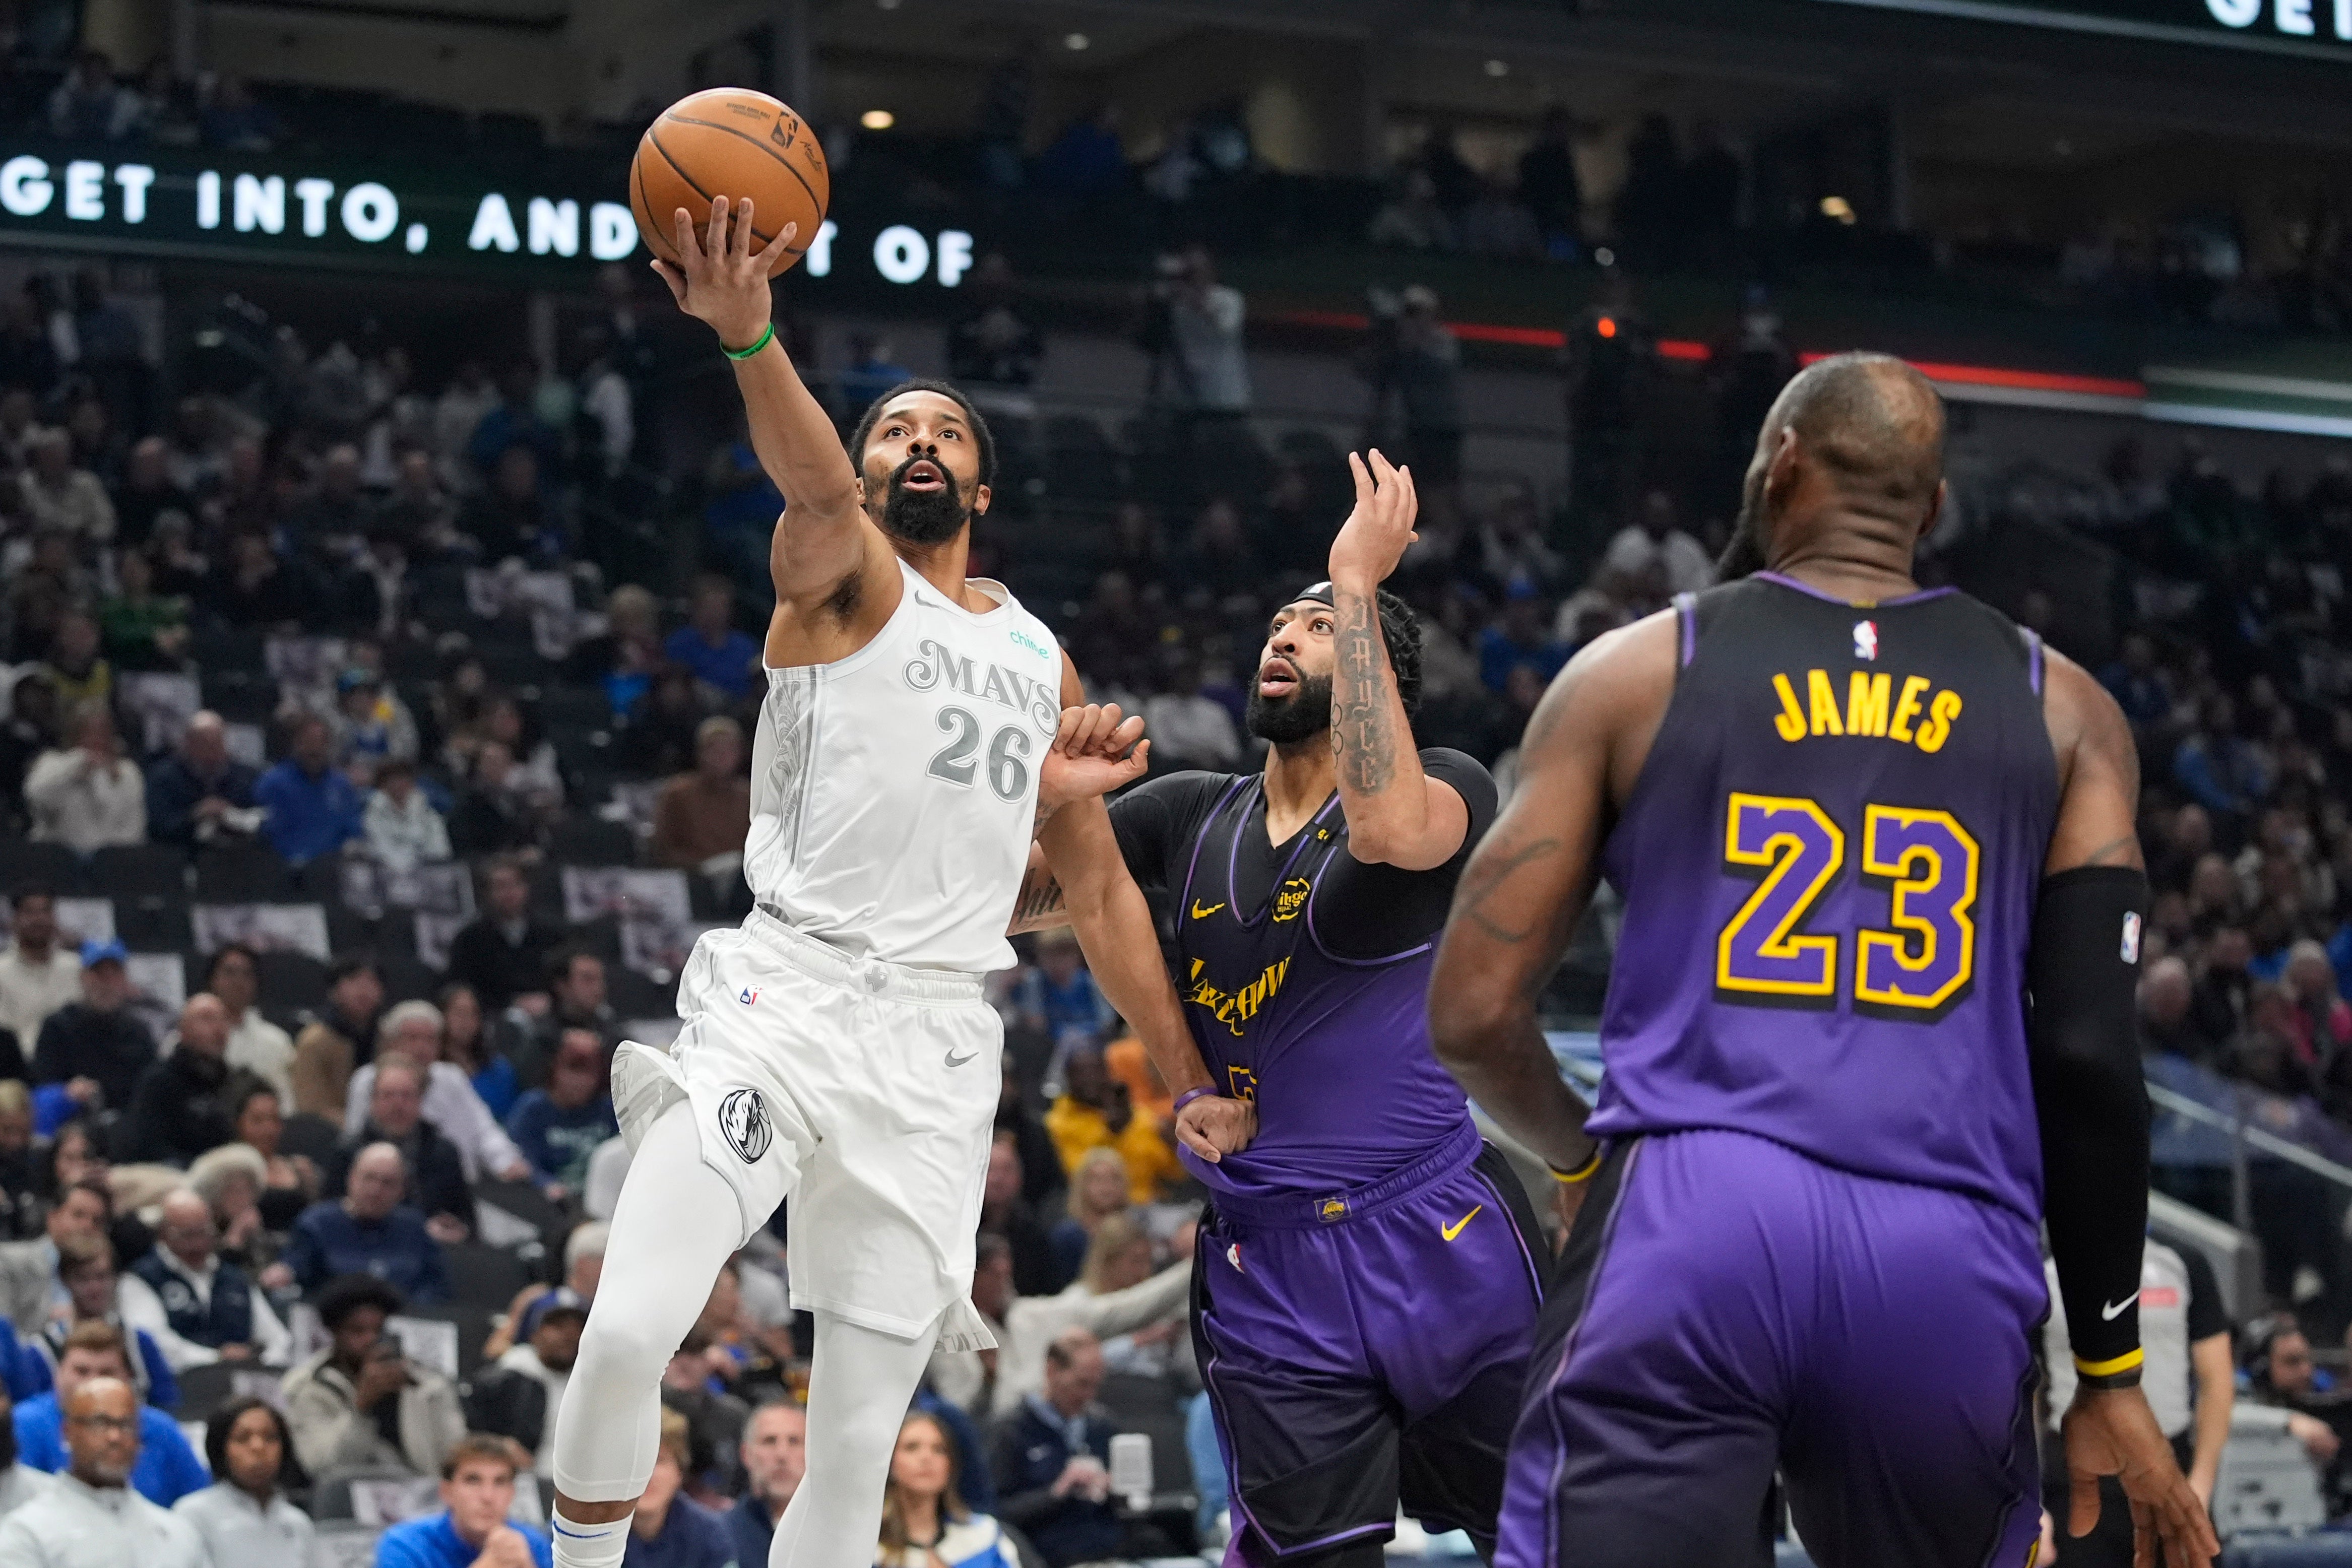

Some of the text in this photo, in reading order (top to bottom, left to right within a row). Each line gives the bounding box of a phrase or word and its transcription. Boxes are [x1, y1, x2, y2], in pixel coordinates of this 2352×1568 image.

[0, 155, 155, 223] GET
[196, 170, 428, 253] INTO,
[467, 192, 639, 260] AND
[873, 225, 973, 288] OF
[903, 638, 1060, 740] MAVS
[1771, 668, 1963, 754] JAMES
[925, 705, 1033, 804] 26
[1714, 791, 1981, 1010] 23
